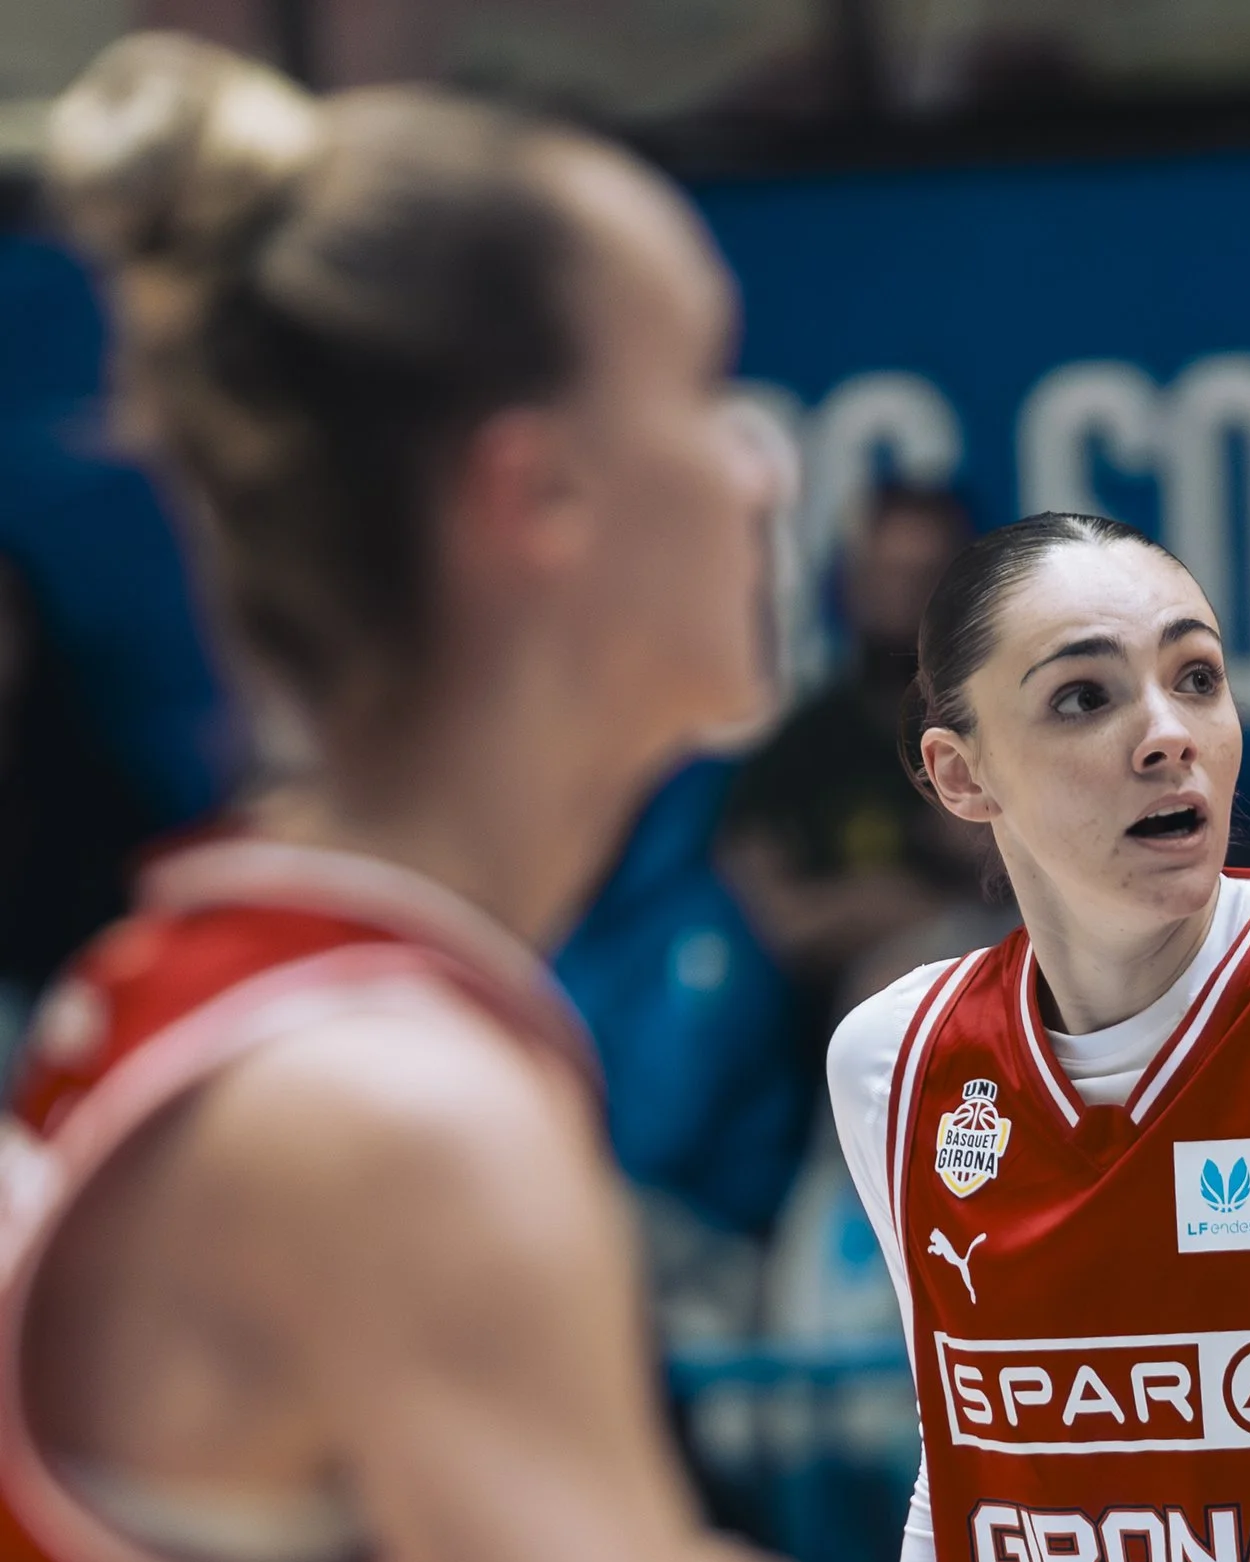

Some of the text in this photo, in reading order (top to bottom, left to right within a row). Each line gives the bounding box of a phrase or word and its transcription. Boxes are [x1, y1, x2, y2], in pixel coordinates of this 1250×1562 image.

[964, 1081, 997, 1099] UNI
[945, 1128, 998, 1149] BÀSQUET
[938, 1148, 995, 1175] GIRONA
[1187, 1222, 1208, 1235] LF
[953, 1360, 1195, 1427] SPAR
